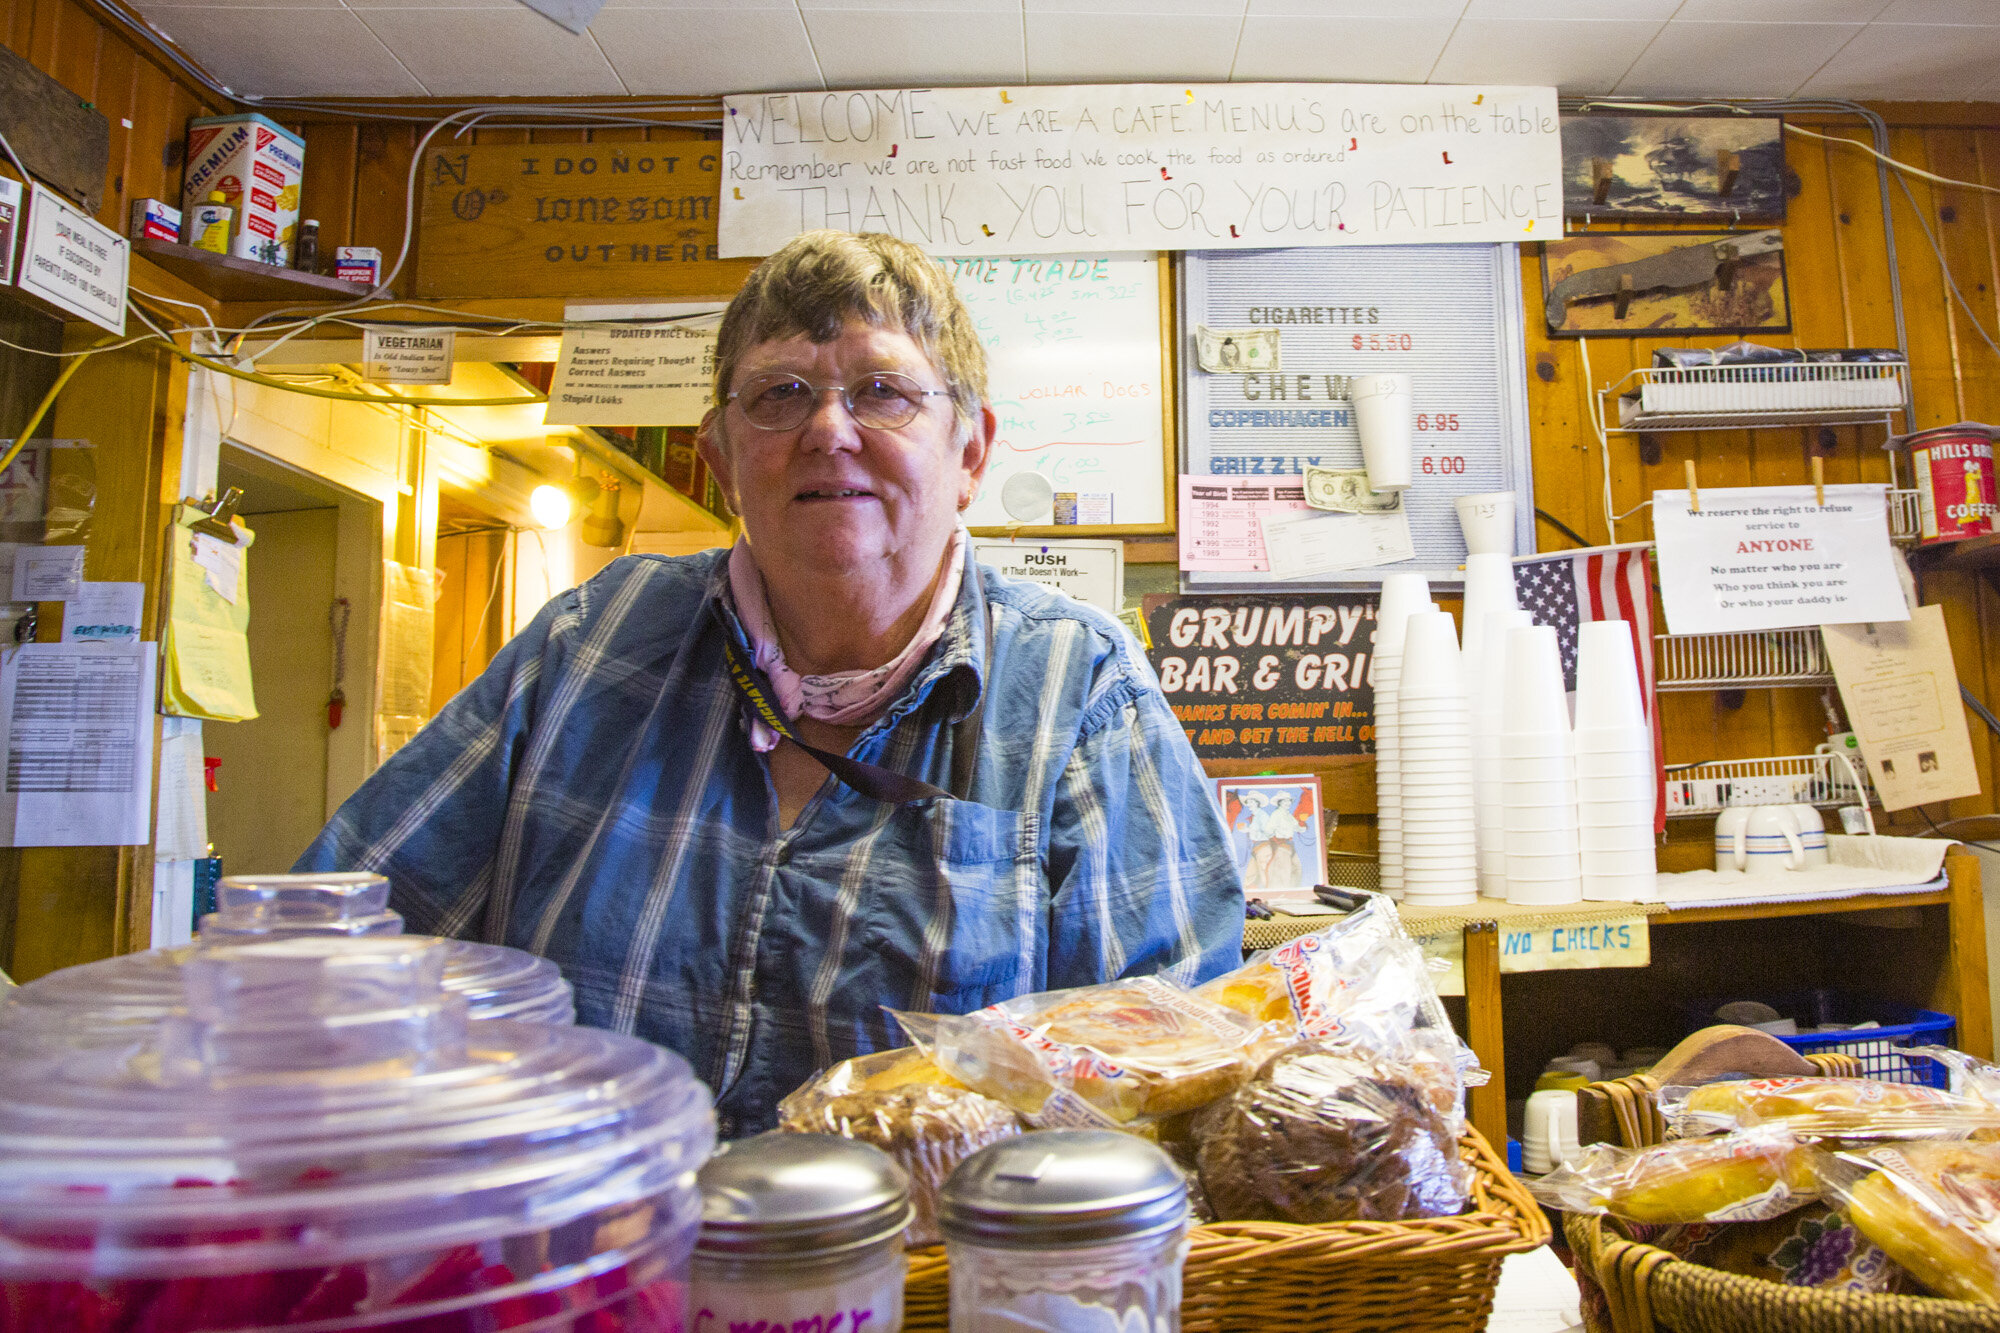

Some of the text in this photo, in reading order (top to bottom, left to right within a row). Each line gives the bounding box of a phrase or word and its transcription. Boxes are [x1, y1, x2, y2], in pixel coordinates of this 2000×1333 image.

[723, 88, 936, 146] WELCOME
[946, 109, 1001, 137] WE
[1015, 108, 1064, 135] ARE
[1074, 106, 1100, 134] A
[1341, 106, 1388, 135] are
[1399, 114, 1434, 135] on
[1440, 101, 1481, 135] the
[1488, 103, 1559, 135] table
[185, 126, 250, 196] PREMIUM
[521, 157, 540, 176] I
[554, 157, 598, 176] DO
[611, 156, 680, 174] NOT
[726, 150, 853, 181] Remember
[863, 157, 896, 177] we
[905, 158, 940, 176] are
[947, 149, 977, 174] not
[986, 149, 1028, 172] fast
[1116, 147, 1160, 167] cook
[1166, 147, 1197, 166] the
[1207, 146, 1243, 165] food
[1255, 151, 1276, 165] as
[777, 179, 1560, 246] THANK YOU FOR YOUR PATIENCE
[545, 244, 719, 263] OUT HERE
[34, 253, 62, 278] PARENTS
[1009, 256, 1110, 285] MADE
[1249, 306, 1380, 325] CIGARETTES
[610, 328, 652, 339] UPDATED
[653, 328, 682, 339] PRICE
[377, 335, 444, 349] VEGETARIAN
[573, 345, 611, 356] Answers
[570, 356, 609, 366] Answers
[611, 357, 656, 368] Requiring
[658, 356, 697, 367] Thought
[568, 366, 605, 377] Correct
[607, 367, 647, 378] Answers
[1103, 381, 1152, 399] DOGS
[1242, 374, 1353, 401] CHEW
[561, 394, 623, 405] Stupid Looks
[1208, 409, 1460, 432] COPENHAGEN 6.95
[1930, 444, 1971, 461] HILLS
[1421, 456, 1466, 475] 6.00
[1201, 501, 1220, 509] 1994
[1247, 501, 1257, 509] 17
[1687, 503, 1854, 518] We reserve the right to refuse
[1201, 510, 1220, 518] 1993
[1201, 520, 1220, 528] 1992
[1745, 521, 1801, 531] service to
[1247, 530, 1257, 538] 20
[1247, 539, 1257, 547] 21
[1736, 538, 1815, 554] ANYONE
[1024, 554, 1067, 566] PUSH
[1247, 549, 1257, 557] 22
[1002, 567, 1008, 576] If
[1010, 566, 1027, 576] That
[1029, 567, 1058, 577] Doesn't
[1710, 565, 1727, 575] No
[1729, 564, 1769, 575] matter
[1771, 563, 1798, 574] who
[1799, 563, 1821, 574] you
[1713, 582, 1740, 593] Who
[1741, 582, 1765, 593] you
[1766, 581, 1800, 591] think
[1801, 579, 1824, 590] you
[1720, 599, 1736, 609] Or
[1738, 598, 1765, 608] who
[1765, 598, 1796, 609] your
[1797, 593, 1833, 606] daddy
[1159, 654, 1241, 695] BAR
[1252, 654, 1281, 692] &
[1171, 701, 1369, 722] HANKS FOR COMIN' IN...
[1198, 729, 1235, 746] AND
[1239, 727, 1274, 744] GET
[1276, 726, 1310, 744] THE
[1313, 725, 1354, 743] HELL
[1504, 922, 1632, 956] NO CHECKS
